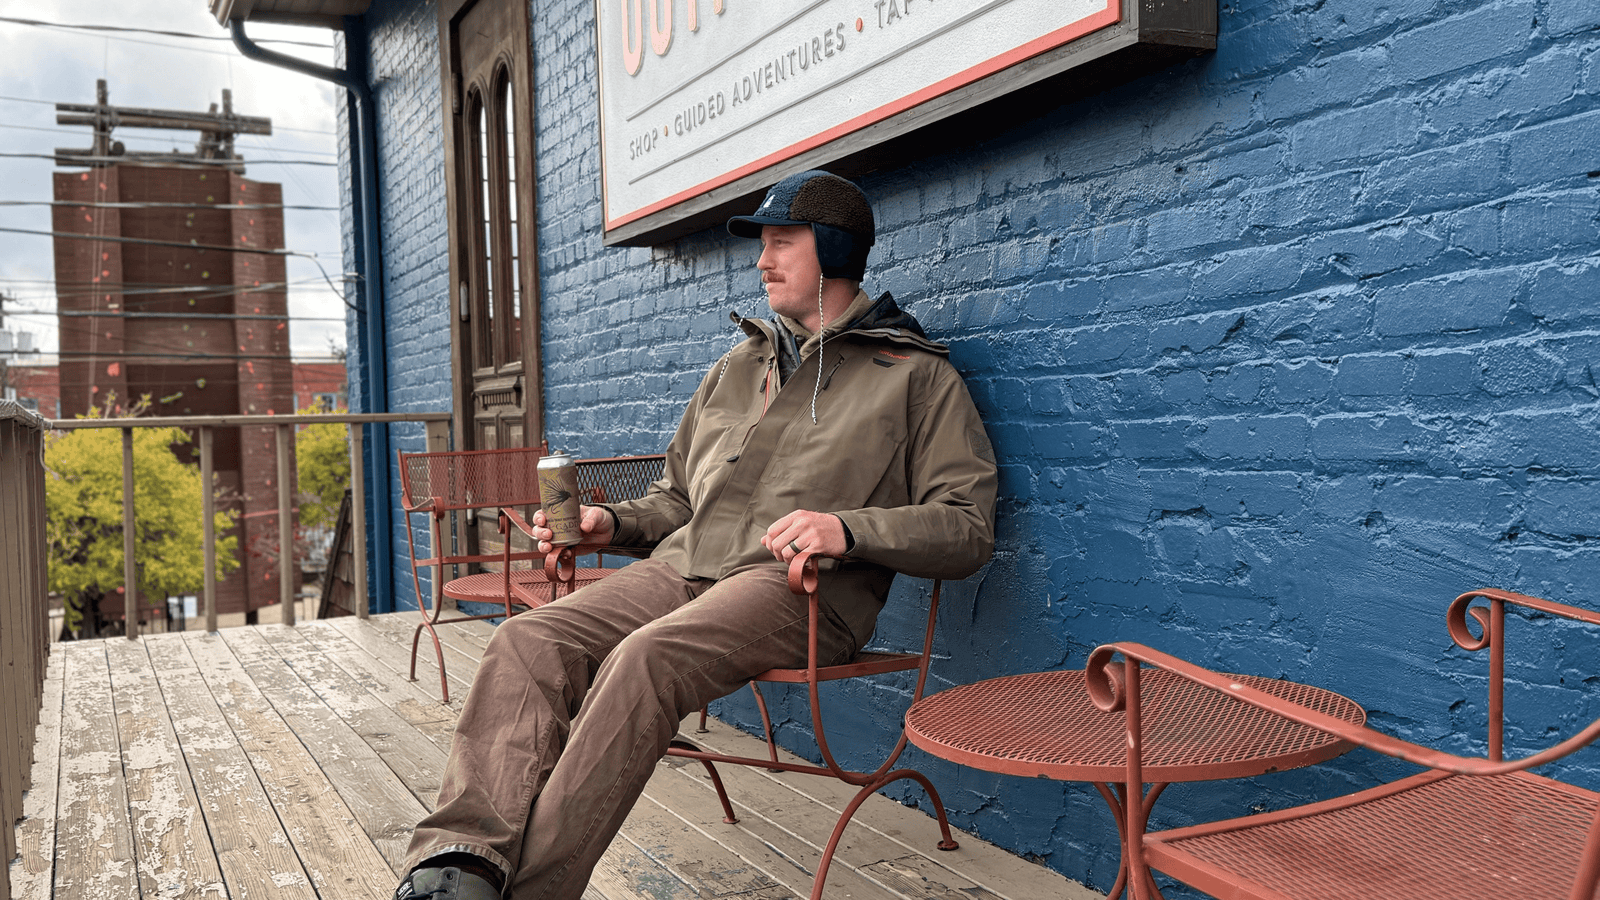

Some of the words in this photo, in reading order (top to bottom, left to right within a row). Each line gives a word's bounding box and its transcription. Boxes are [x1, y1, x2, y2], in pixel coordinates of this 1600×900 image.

[629, 127, 659, 161] SHOP
[674, 91, 726, 137] GUIDED
[731, 22, 847, 107] ADVENTURES
